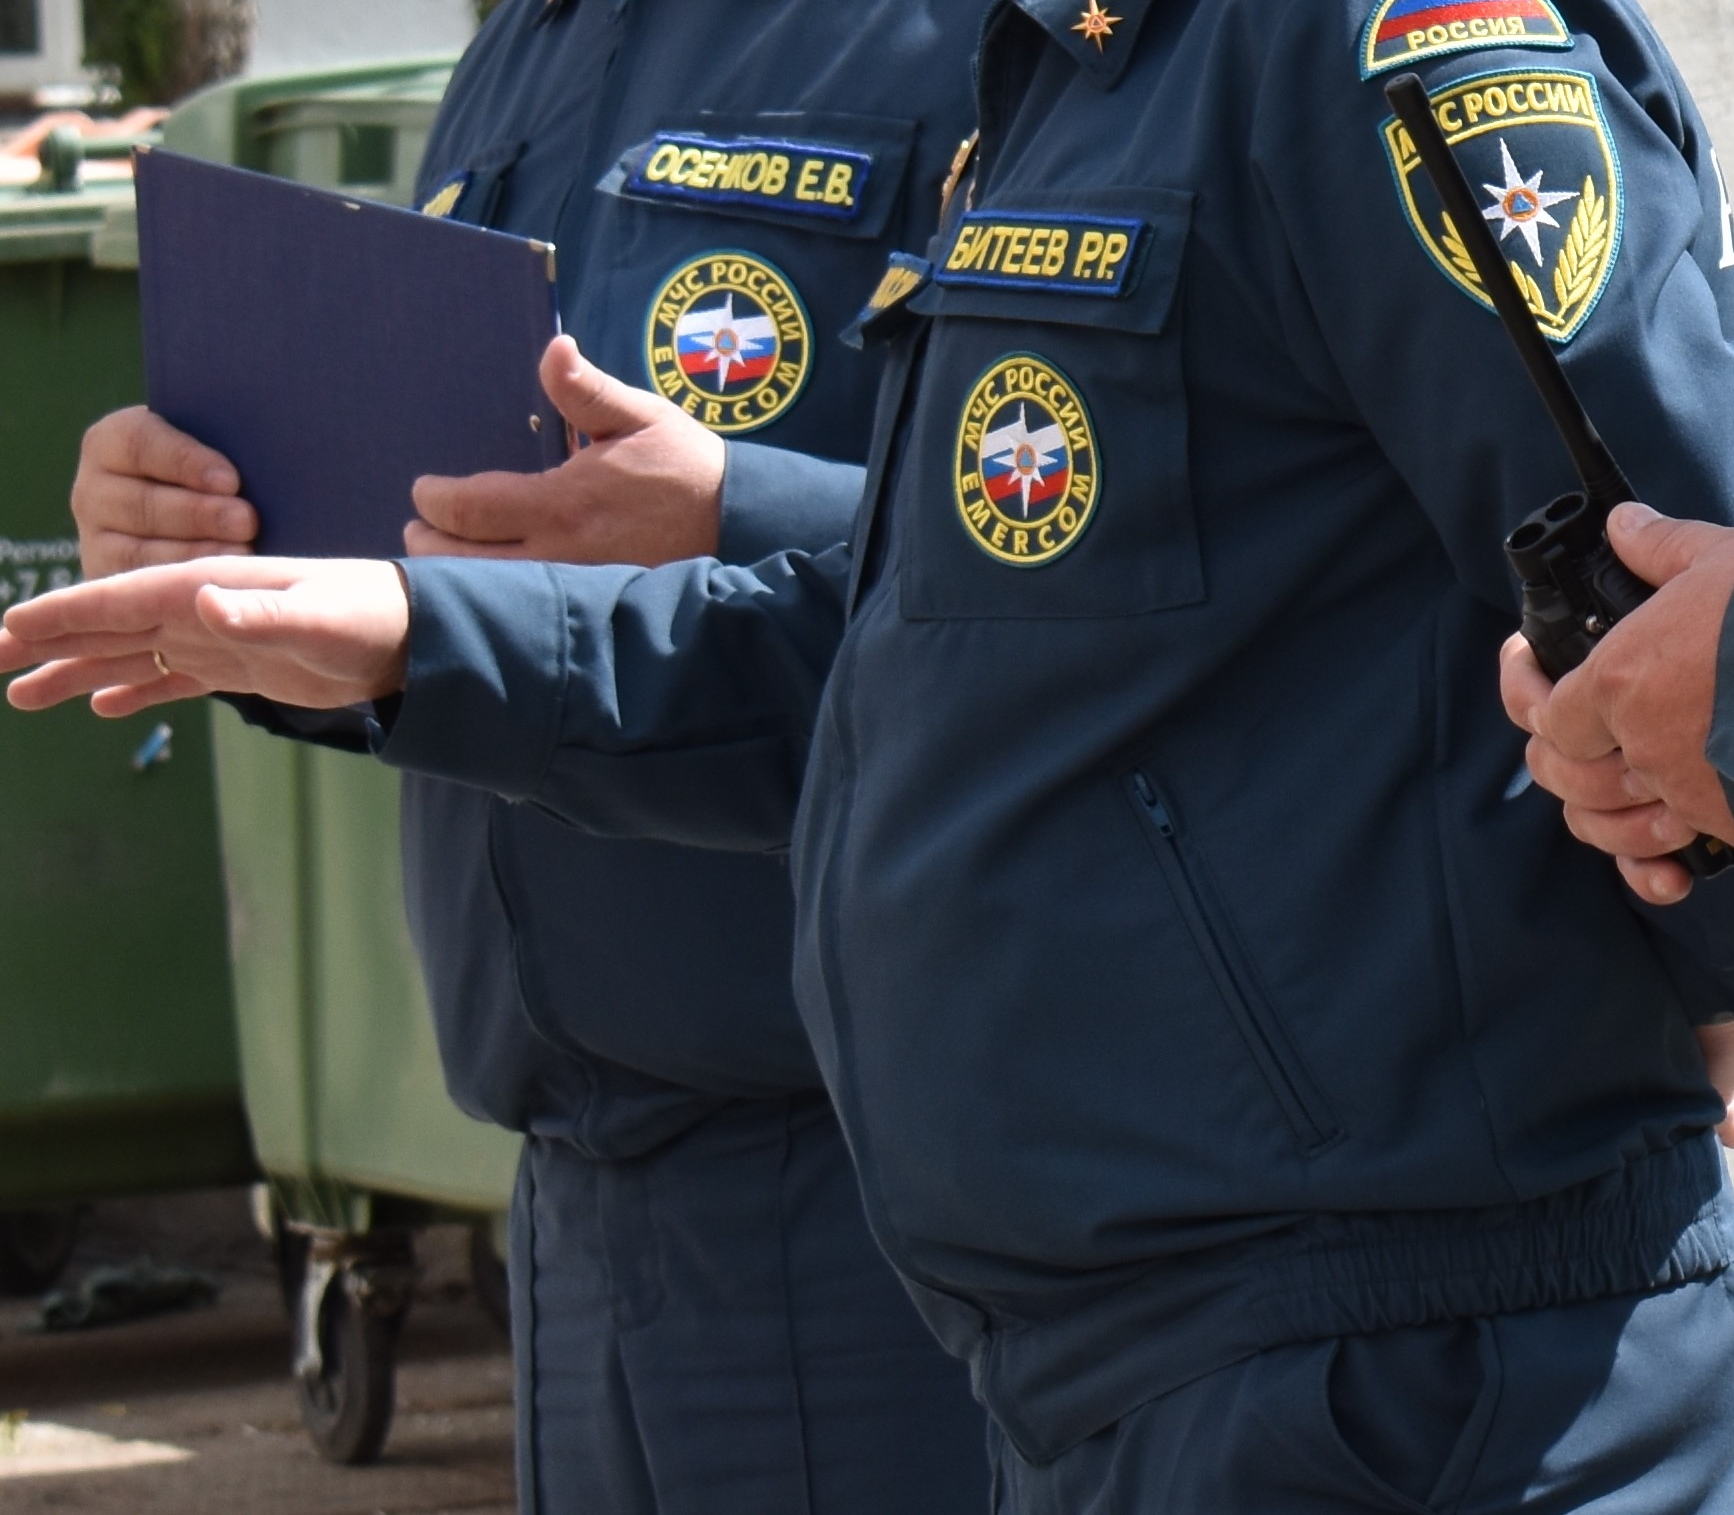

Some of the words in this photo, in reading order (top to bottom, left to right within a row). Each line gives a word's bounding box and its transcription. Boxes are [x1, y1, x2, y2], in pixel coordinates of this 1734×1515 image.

[1406, 17, 1527, 51] РОССИЯ
[1462, 82, 1591, 124] РОССИИ
[646, 144, 790, 195] ОСЕНКОВ
[795, 160, 854, 206] Е.В.
[946, 226, 1069, 277] БИТЕЕВ
[1073, 231, 1128, 280] Р.Р.
[658, 269, 704, 329] МЧС
[711, 261, 802, 341] РОССИИ
[654, 346, 801, 423] EMERCOM
[964, 381, 1000, 450] МЧС
[1005, 366, 1089, 451] РОССИИ
[963, 473, 1091, 554] EMERCOM
